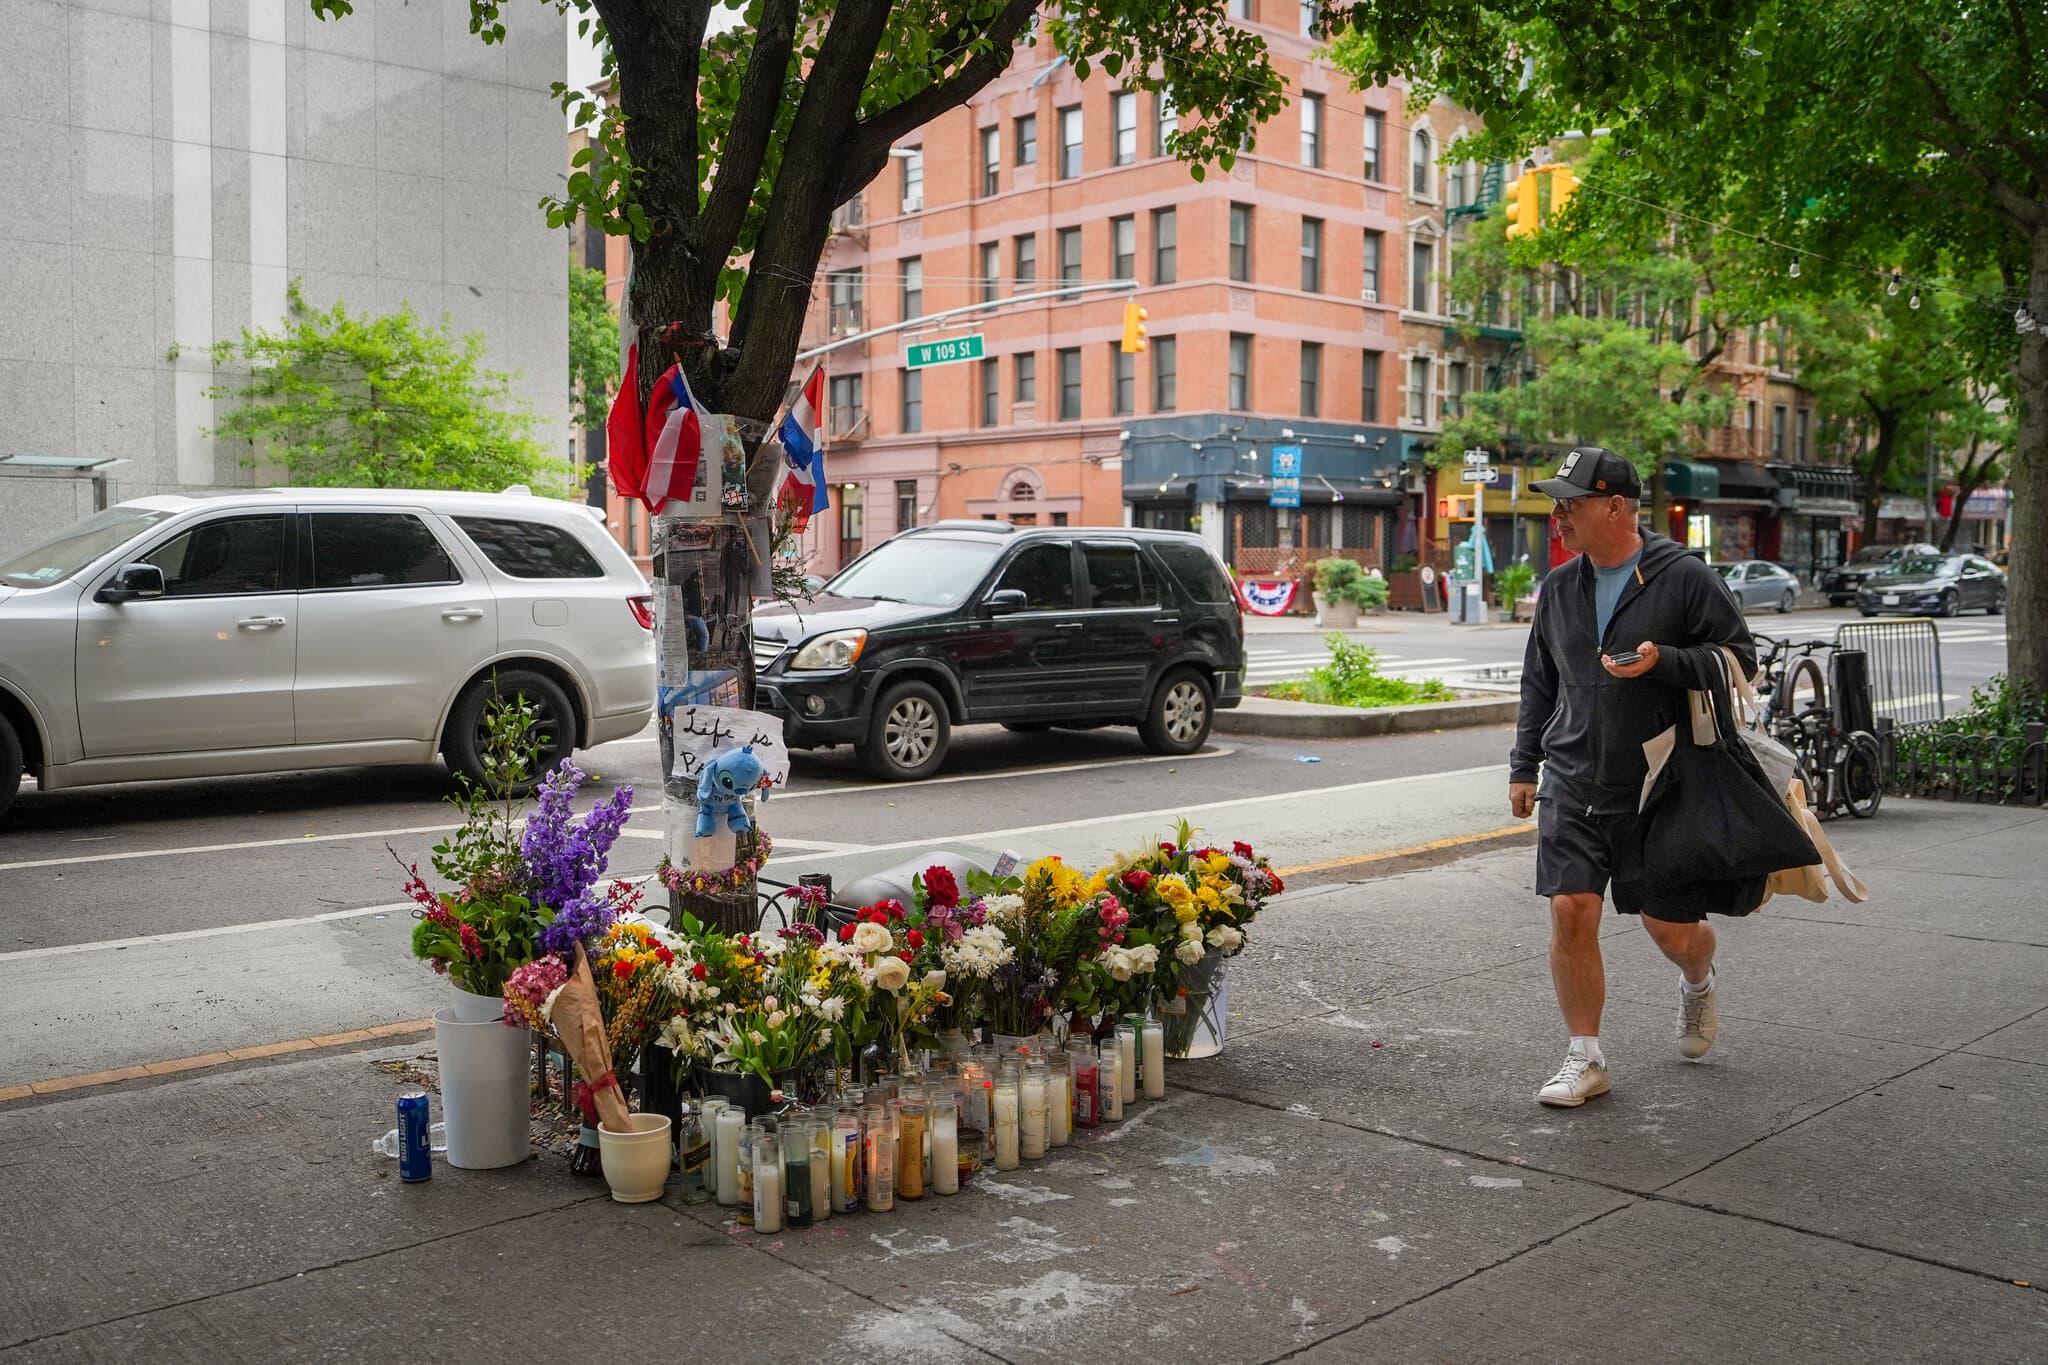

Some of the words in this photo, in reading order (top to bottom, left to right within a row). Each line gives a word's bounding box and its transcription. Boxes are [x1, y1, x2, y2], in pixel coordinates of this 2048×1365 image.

[921, 346, 932, 362] W
[936, 343, 956, 360] 109
[683, 708, 735, 748] Life
[749, 727, 773, 746] is
[399, 1112, 407, 1141] LIGHT
[400, 1142, 408, 1162] BUD
